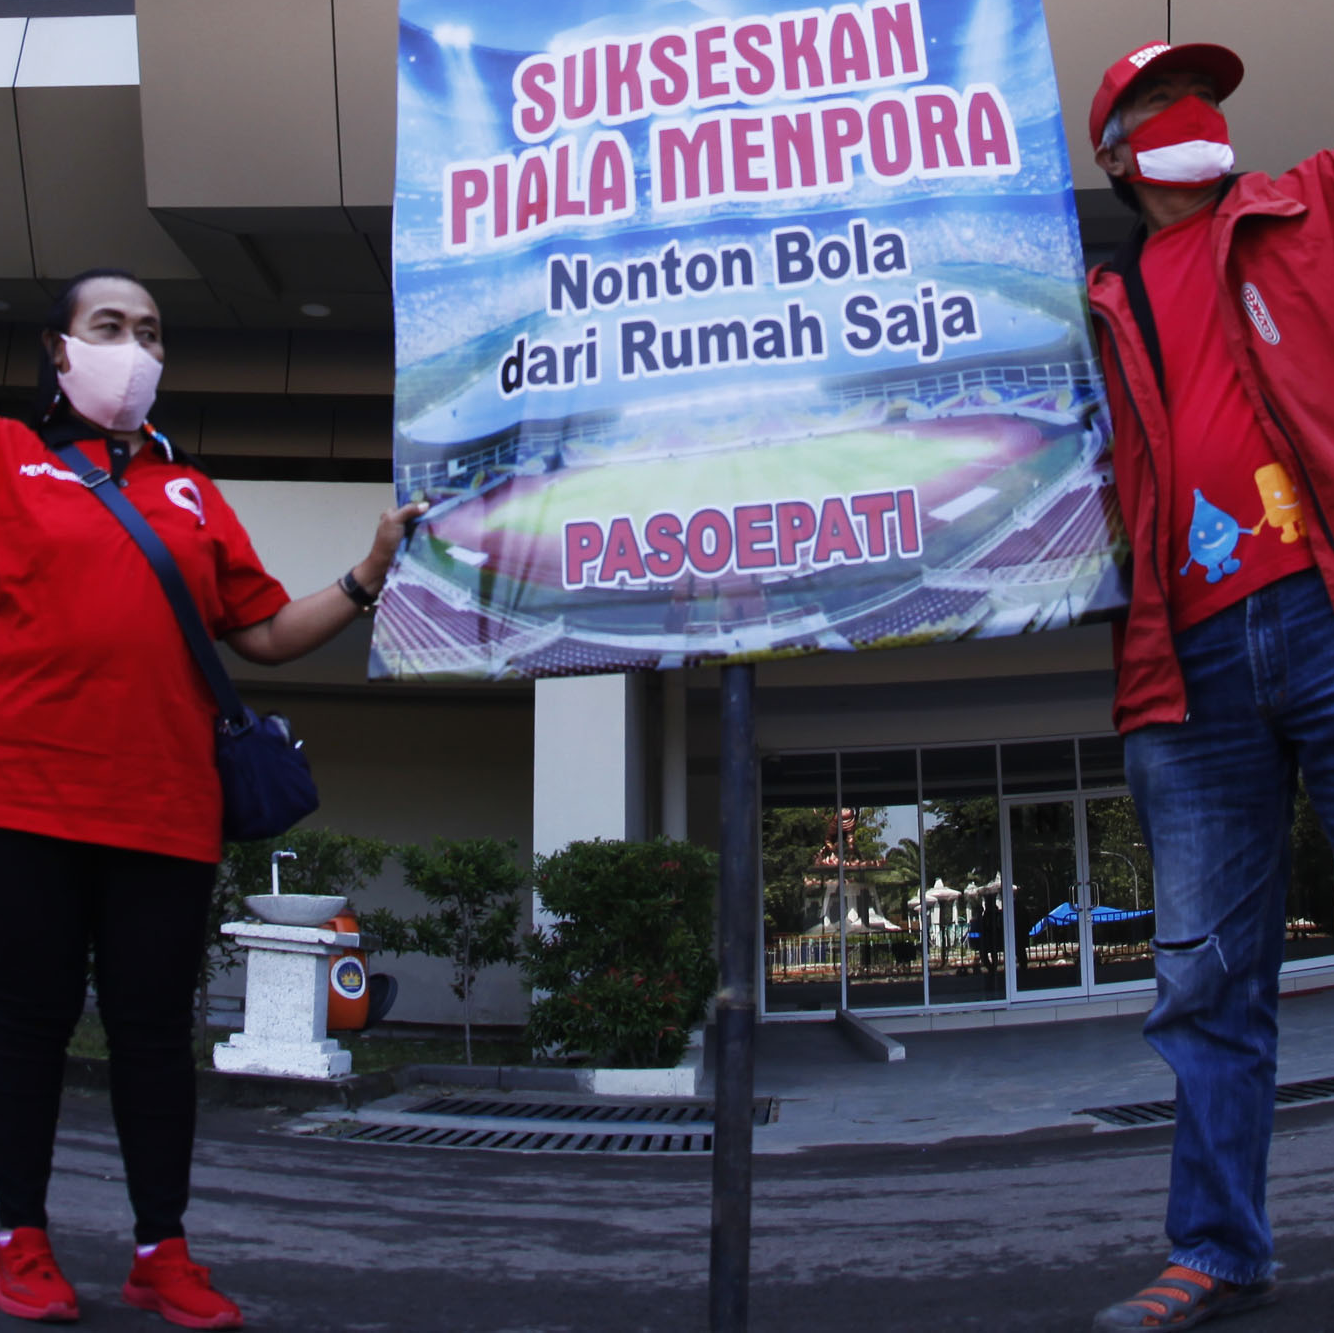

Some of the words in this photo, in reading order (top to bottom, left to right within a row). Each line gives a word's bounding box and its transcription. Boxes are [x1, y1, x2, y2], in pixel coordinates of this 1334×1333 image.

[519, 2, 920, 135] SUKSESKAN
[450, 139, 627, 245] PIALA
[658, 91, 1012, 204] MENPORA
[549, 245, 753, 312] Nonton
[775, 223, 906, 285] Bola
[500, 329, 598, 395] dari
[621, 304, 824, 375] Rumah
[846, 286, 976, 358] Saja
[564, 490, 921, 587] PASOEPATI
